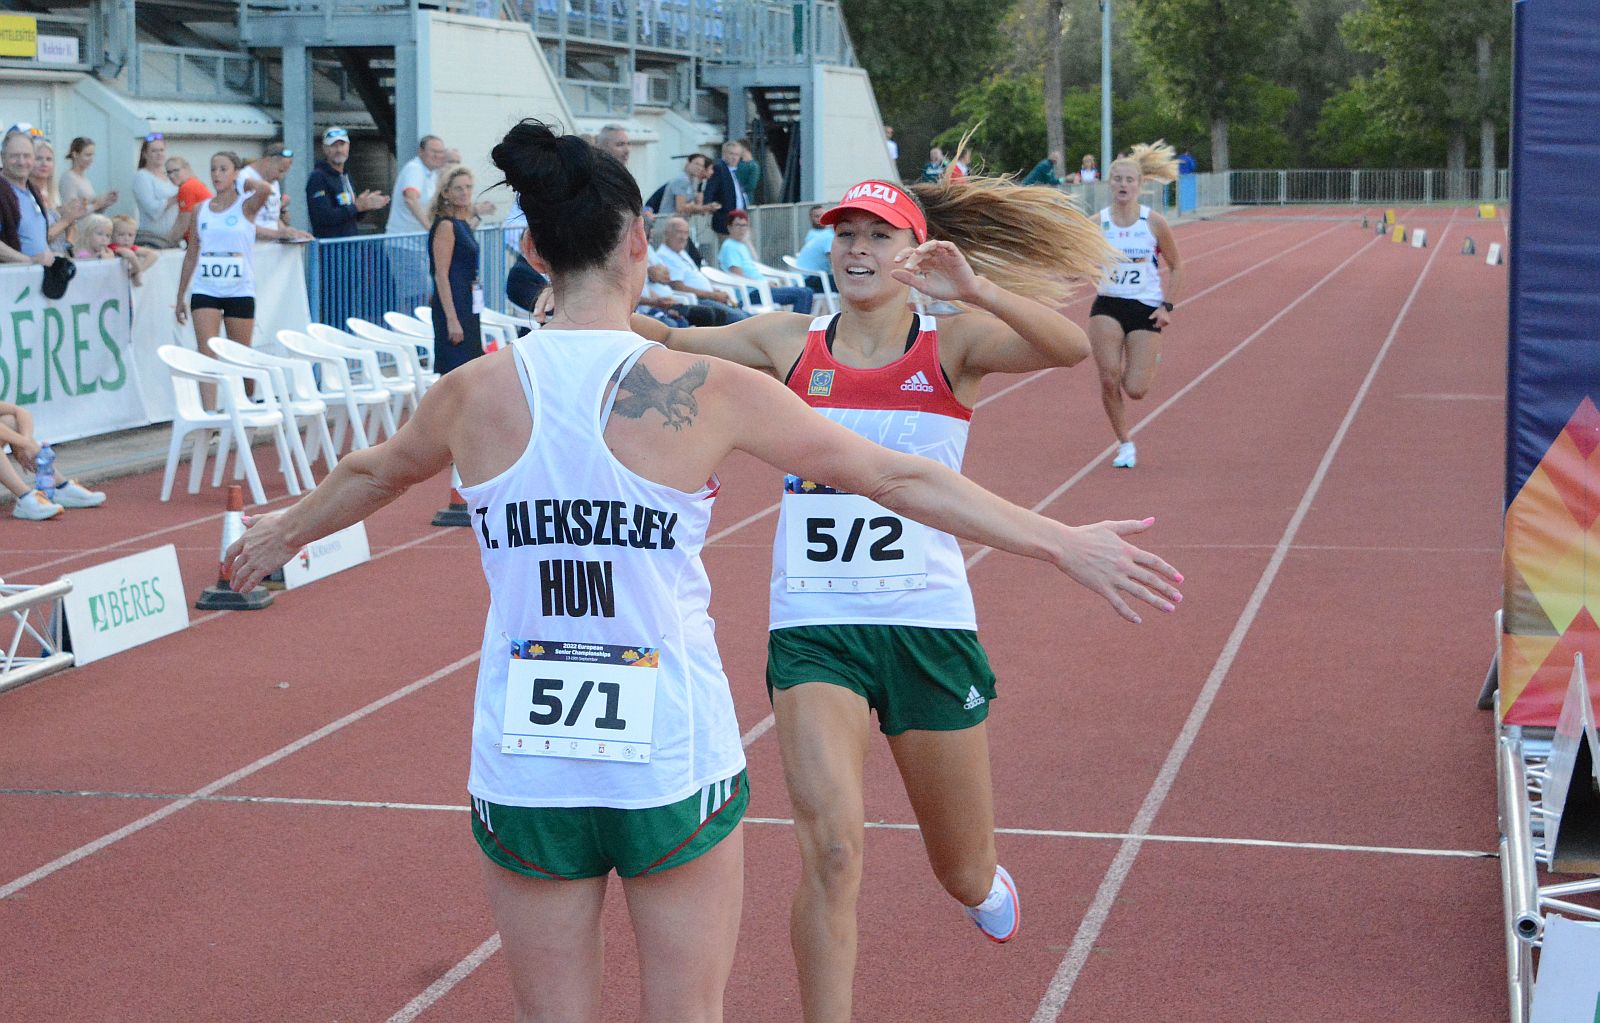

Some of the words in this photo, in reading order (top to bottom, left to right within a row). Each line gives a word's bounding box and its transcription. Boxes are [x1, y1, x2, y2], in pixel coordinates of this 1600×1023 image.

[846, 184, 898, 204] MAZU
[201, 264, 243, 278] 10/1
[900, 383, 934, 393] adidas
[475, 506, 499, 549] T.
[505, 498, 678, 550] ALEKSZEJEV
[806, 516, 904, 563] 5/2
[107, 576, 165, 628] BÉRES
[538, 559, 616, 618] HUN
[572, 649, 611, 657] Championships
[529, 678, 626, 730] 5/1
